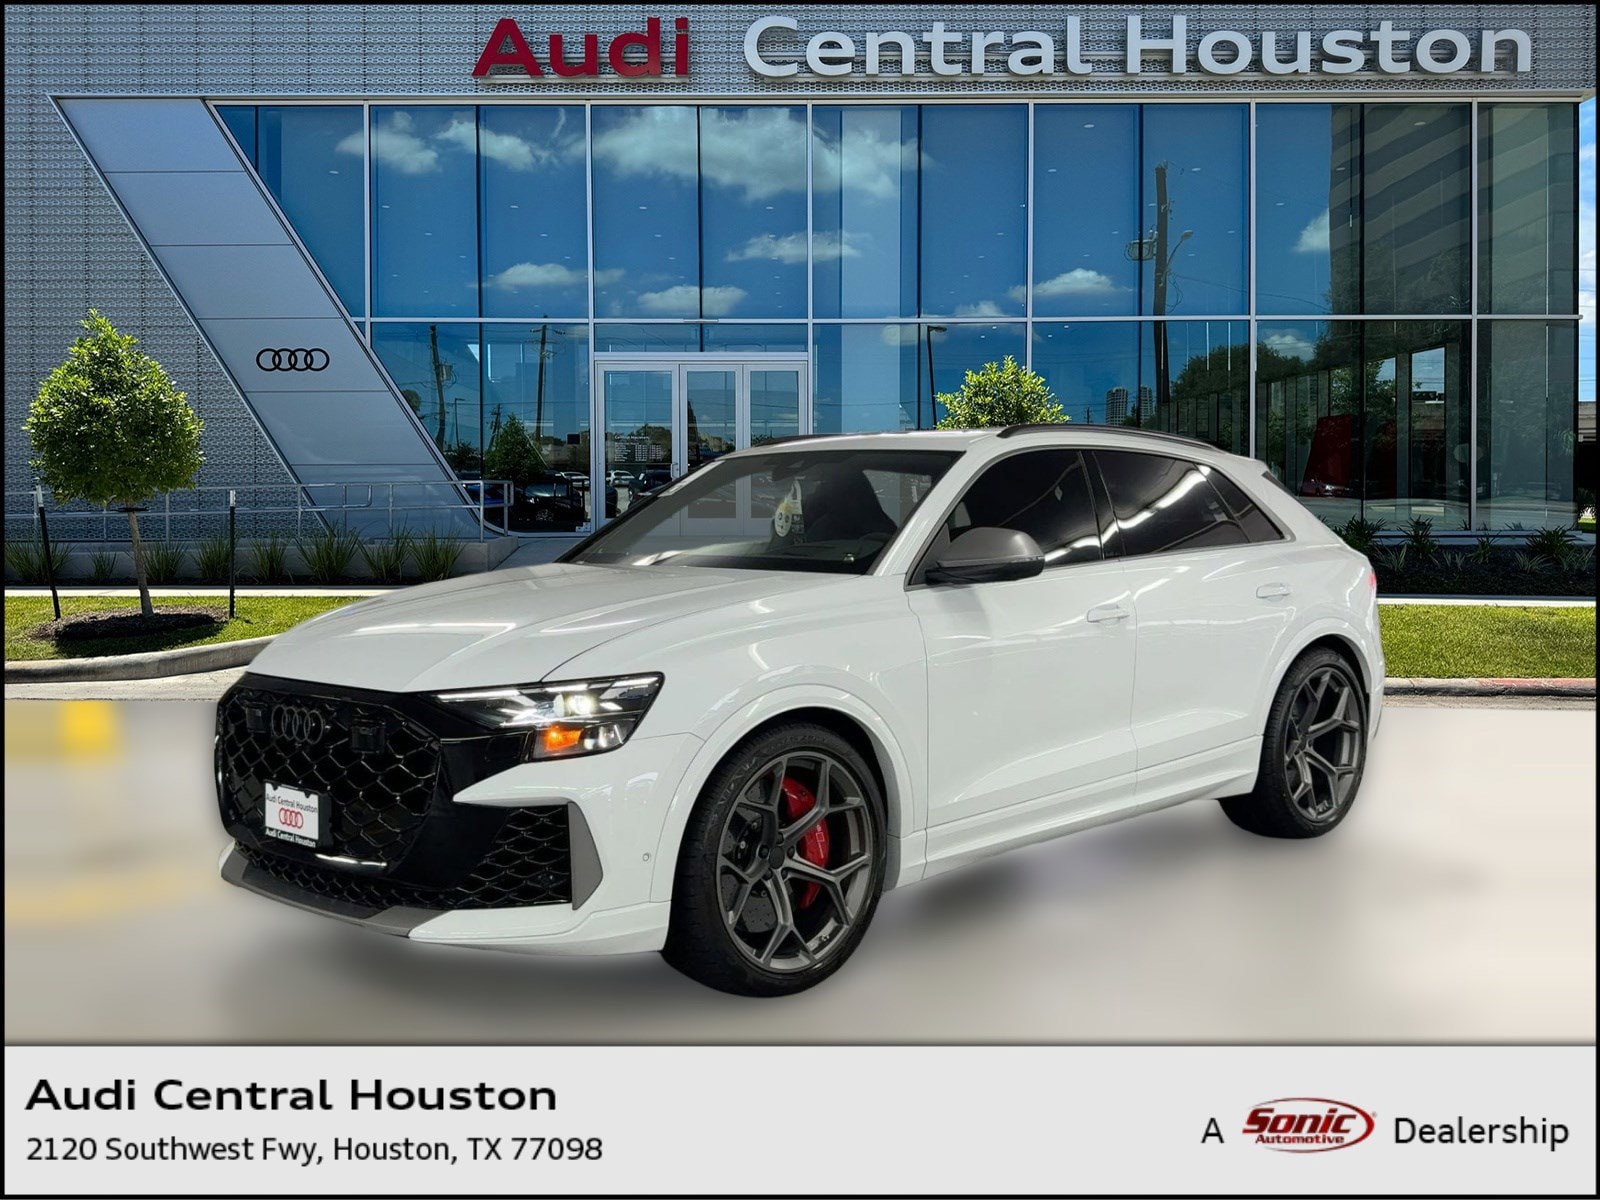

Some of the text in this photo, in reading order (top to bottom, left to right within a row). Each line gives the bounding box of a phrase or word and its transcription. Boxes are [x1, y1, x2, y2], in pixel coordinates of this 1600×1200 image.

[471, 15, 1532, 78] Audi Central Houston
[266, 793, 277, 803] Audi
[278, 796, 295, 808] Central
[265, 828, 277, 838] Audi
